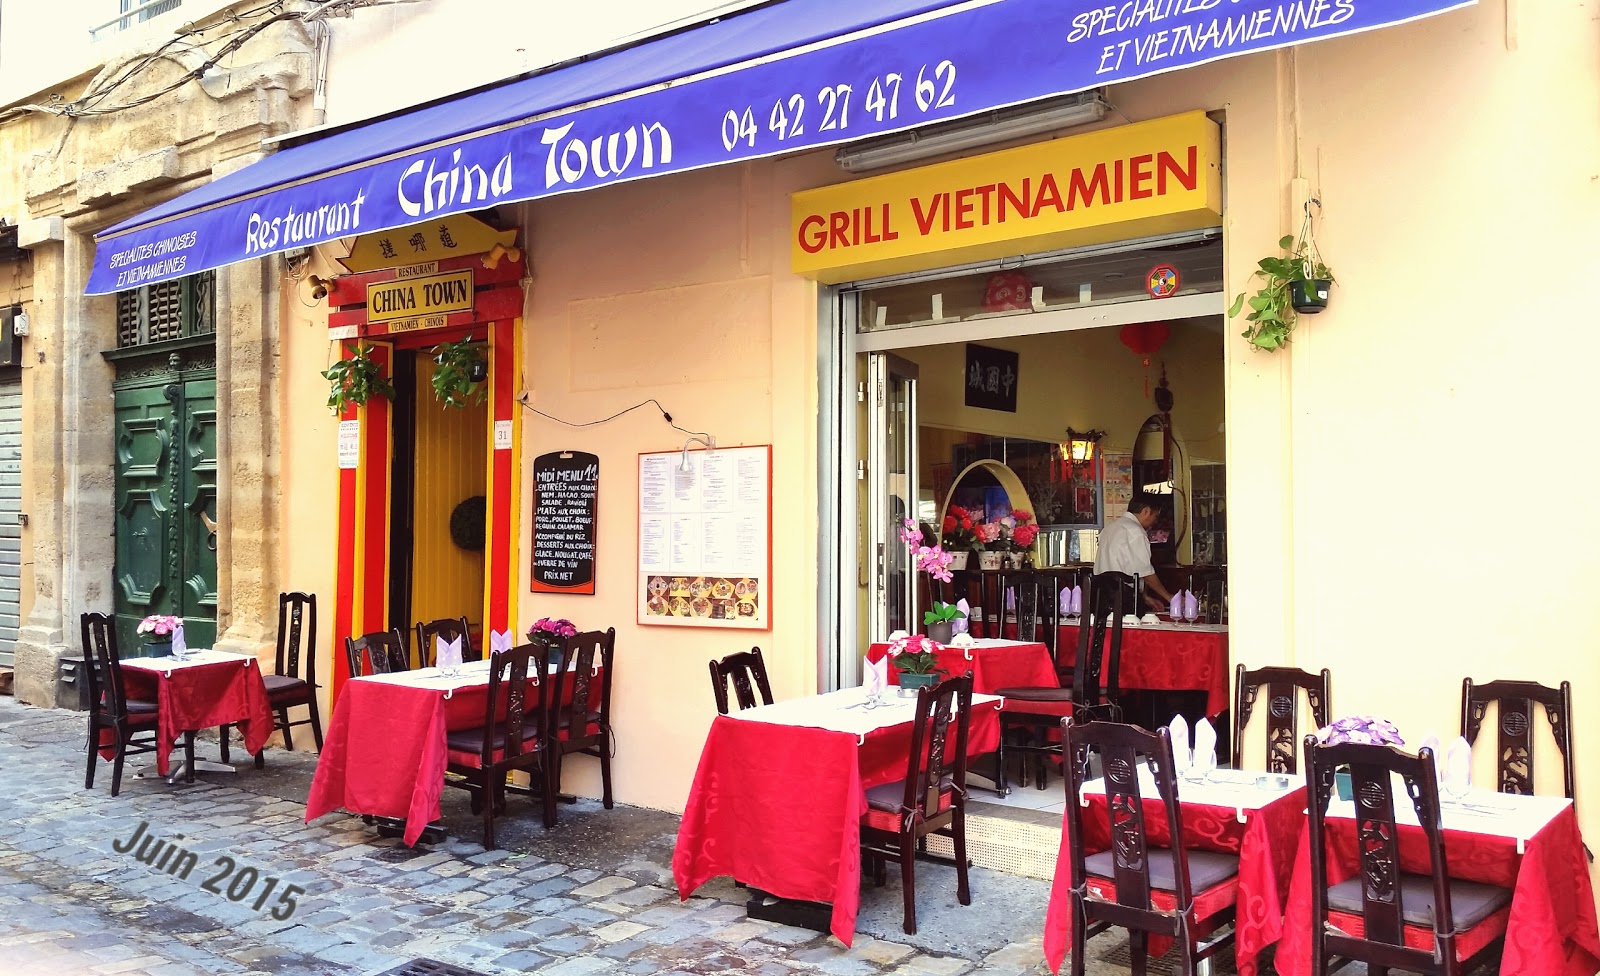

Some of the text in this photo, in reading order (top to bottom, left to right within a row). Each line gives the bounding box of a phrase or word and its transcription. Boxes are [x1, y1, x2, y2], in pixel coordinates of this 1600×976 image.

[1095, 0, 1355, 75] ET VIETNAMIENNES
[245, 59, 956, 254] Restaurant China Town 04 42 27 47 62
[798, 145, 1198, 255] GRILL VIETNAMIEN
[153, 231, 197, 258] CHINOISES
[115, 255, 187, 288] ET VIETNAMIENNES
[398, 263, 435, 278] RESTAURANT
[373, 279, 467, 314] CHINA TOWN
[391, 315, 444, 332] VIETNAMIEN CHINOIS
[498, 430, 507, 440] 31
[556, 470, 584, 481] MENU
[537, 541, 563, 549] DESSERTS
[560, 571, 573, 581] NET
